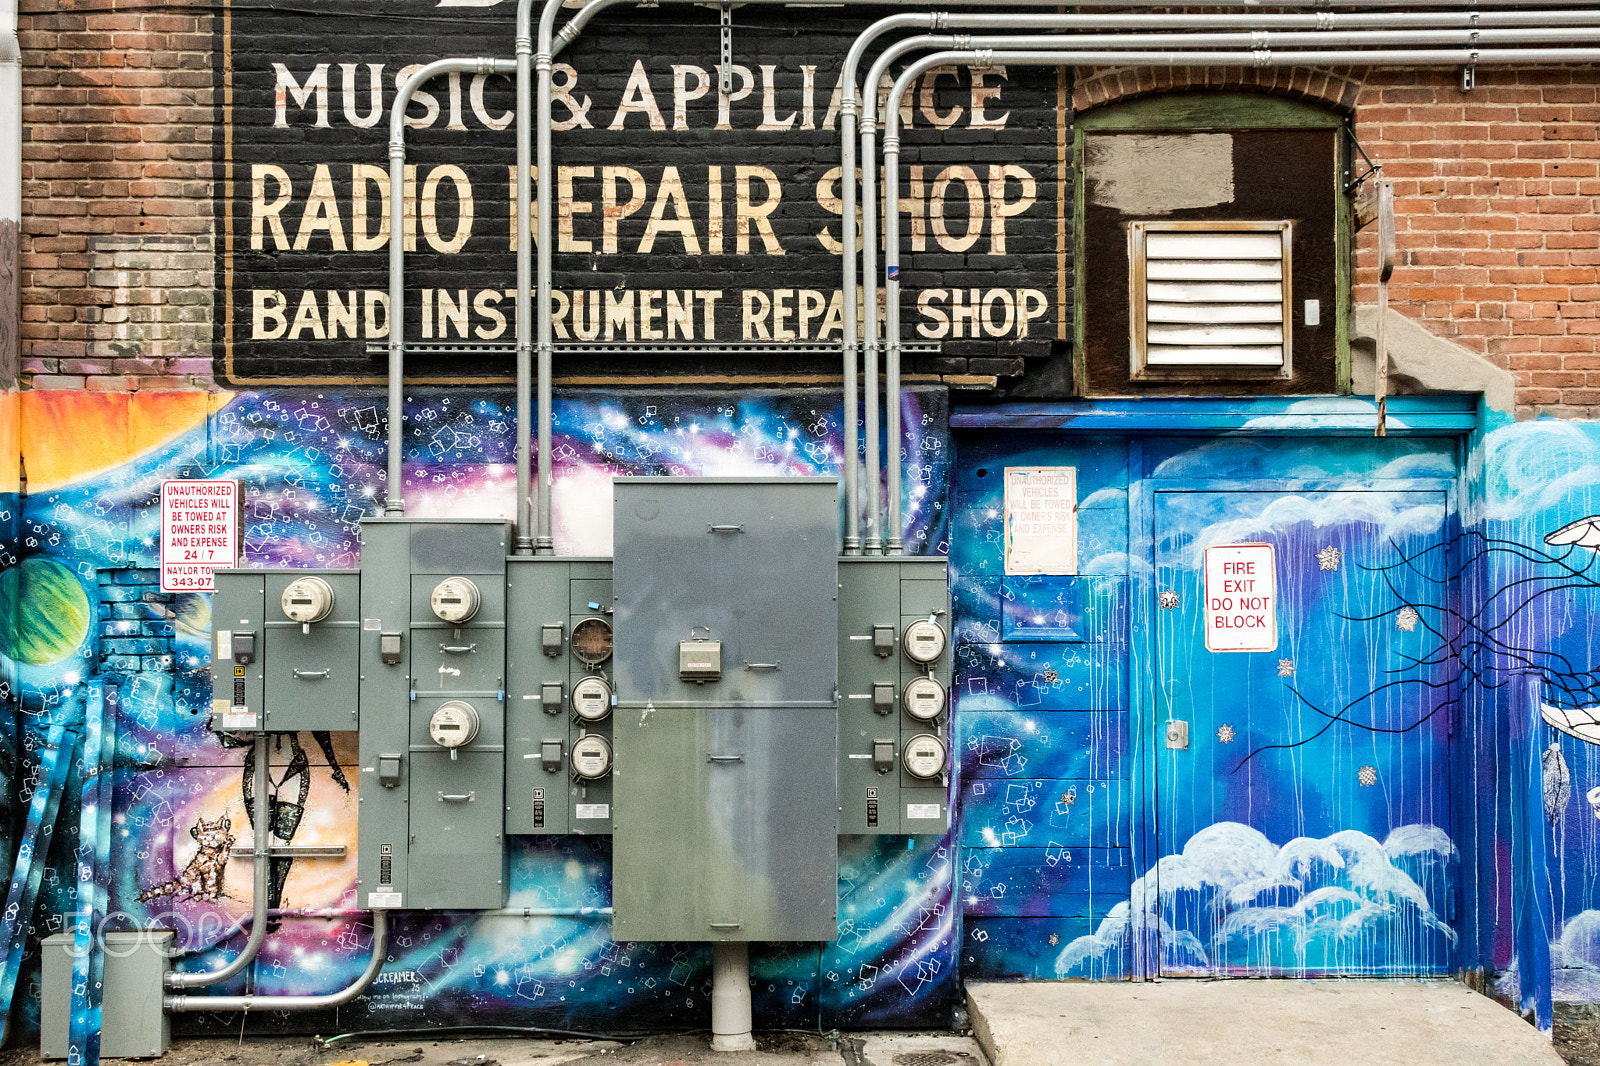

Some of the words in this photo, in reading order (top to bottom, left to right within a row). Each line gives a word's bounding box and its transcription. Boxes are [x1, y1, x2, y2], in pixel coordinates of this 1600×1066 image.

[271, 63, 515, 131] MUSIC
[550, 62, 595, 131] &
[250, 164, 474, 254] RADIO
[816, 164, 1037, 256] SHOP
[251, 289, 390, 340] BAND
[916, 288, 1049, 339] SHOP
[1011, 475, 1069, 485] UNAUTHORIZED
[167, 486, 232, 496] UNAUTHORIZED
[1022, 487, 1059, 497] VEHICLES
[168, 498, 209, 509] VEHICLES
[211, 498, 230, 509] WILL
[1010, 500, 1028, 509] WILL
[1031, 500, 1041, 509] BE
[1045, 499, 1071, 509] TOWED
[172, 511, 182, 521] BE
[185, 511, 214, 521] TOWED
[216, 511, 227, 521] AT
[1054, 511, 1071, 521] RISK
[171, 524, 206, 534] OWNERS
[208, 524, 228, 534] RISK
[1014, 523, 1029, 533] AND
[1033, 523, 1068, 533] EXPENSE
[171, 537, 188, 547] AND
[190, 537, 228, 547] EXPENSE
[184, 550, 198, 560] 24
[208, 550, 215, 560] 7
[167, 566, 199, 575] NAYLOR
[1223, 562, 1256, 575] FIRE
[1224, 580, 1256, 593] EXIT
[1211, 598, 1233, 611] DO
[1240, 597, 1270, 610] NOT
[1215, 615, 1266, 628] BLOCK
